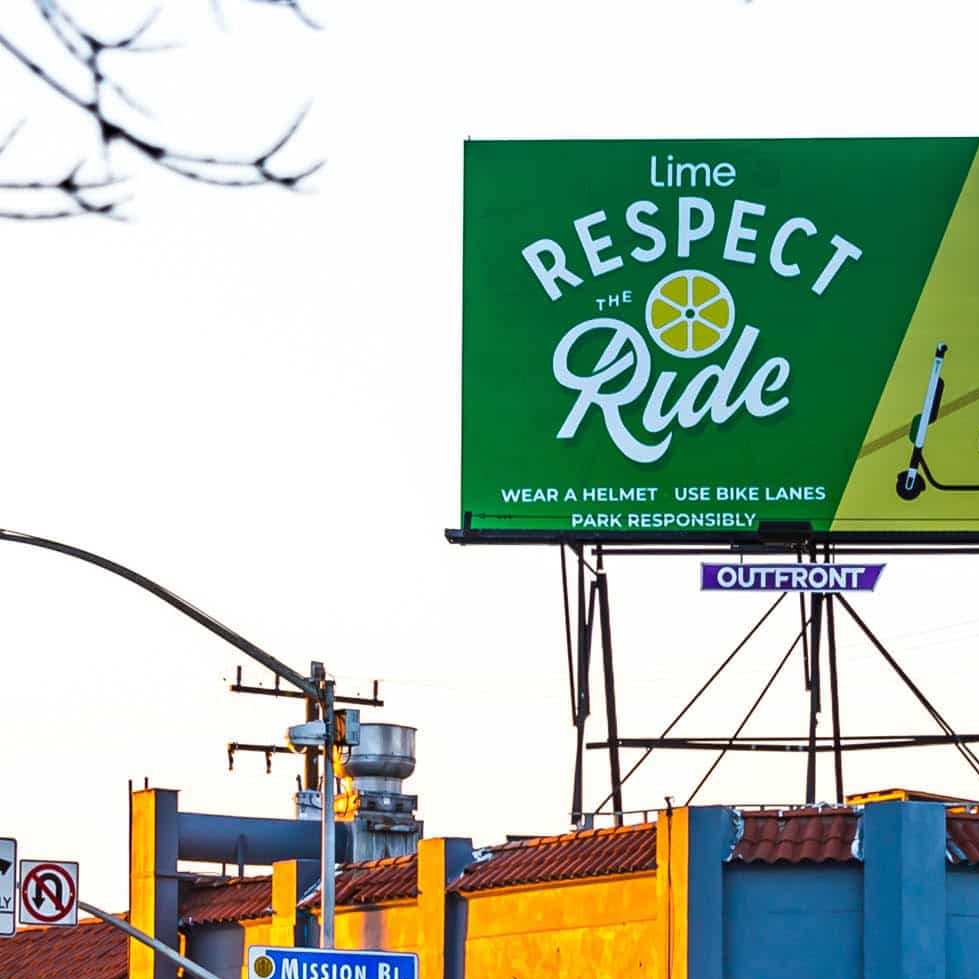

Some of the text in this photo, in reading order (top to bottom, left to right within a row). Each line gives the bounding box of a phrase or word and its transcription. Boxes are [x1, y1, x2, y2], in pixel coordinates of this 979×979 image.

[650, 155, 737, 187] Lime
[521, 196, 863, 301] RESPECT
[596, 290, 632, 312] THE
[553, 317, 790, 463] Ride
[501, 486, 826, 502] WEAR A HELMET USE BIKE LANES
[572, 513, 757, 528] PARK RESPONSIBLY
[716, 566, 865, 589] OUTFRONT
